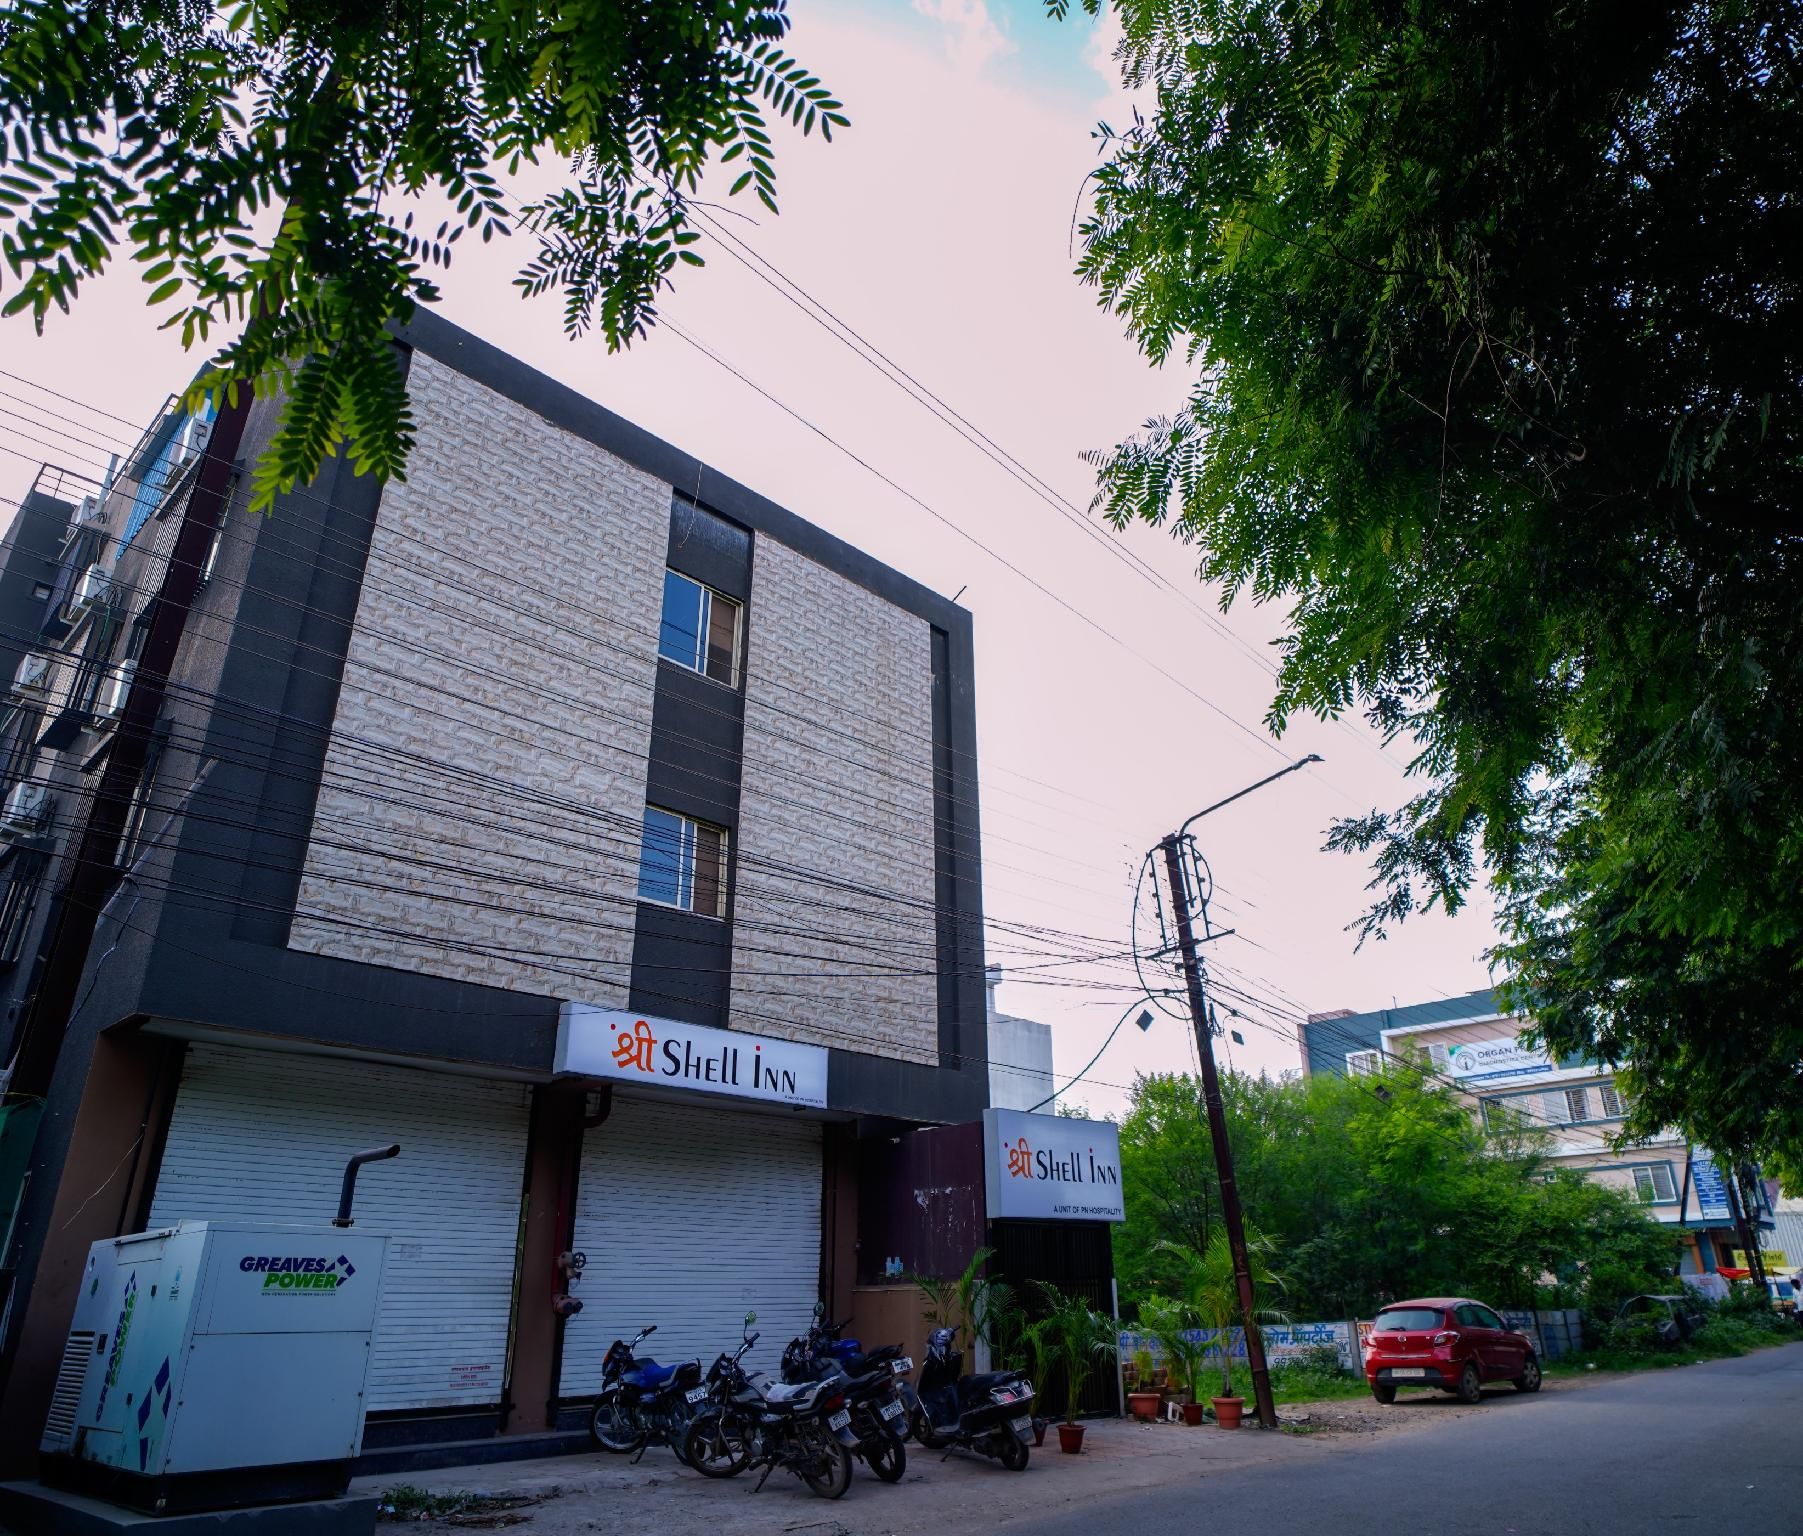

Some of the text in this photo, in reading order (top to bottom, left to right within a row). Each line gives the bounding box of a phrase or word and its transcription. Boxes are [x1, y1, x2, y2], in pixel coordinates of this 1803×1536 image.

[612, 1020, 657, 1072] श्री
[1477, 1047, 1512, 1059] ORGAN
[1008, 1137, 1033, 1179] श्री
[1072, 1206, 1080, 1214] OF
[1081, 1206, 1089, 1214] PN
[1089, 1207, 1122, 1216] HOSPITALITY
[239, 1256, 328, 1273] GREAVES
[263, 1273, 338, 1289] POWER
